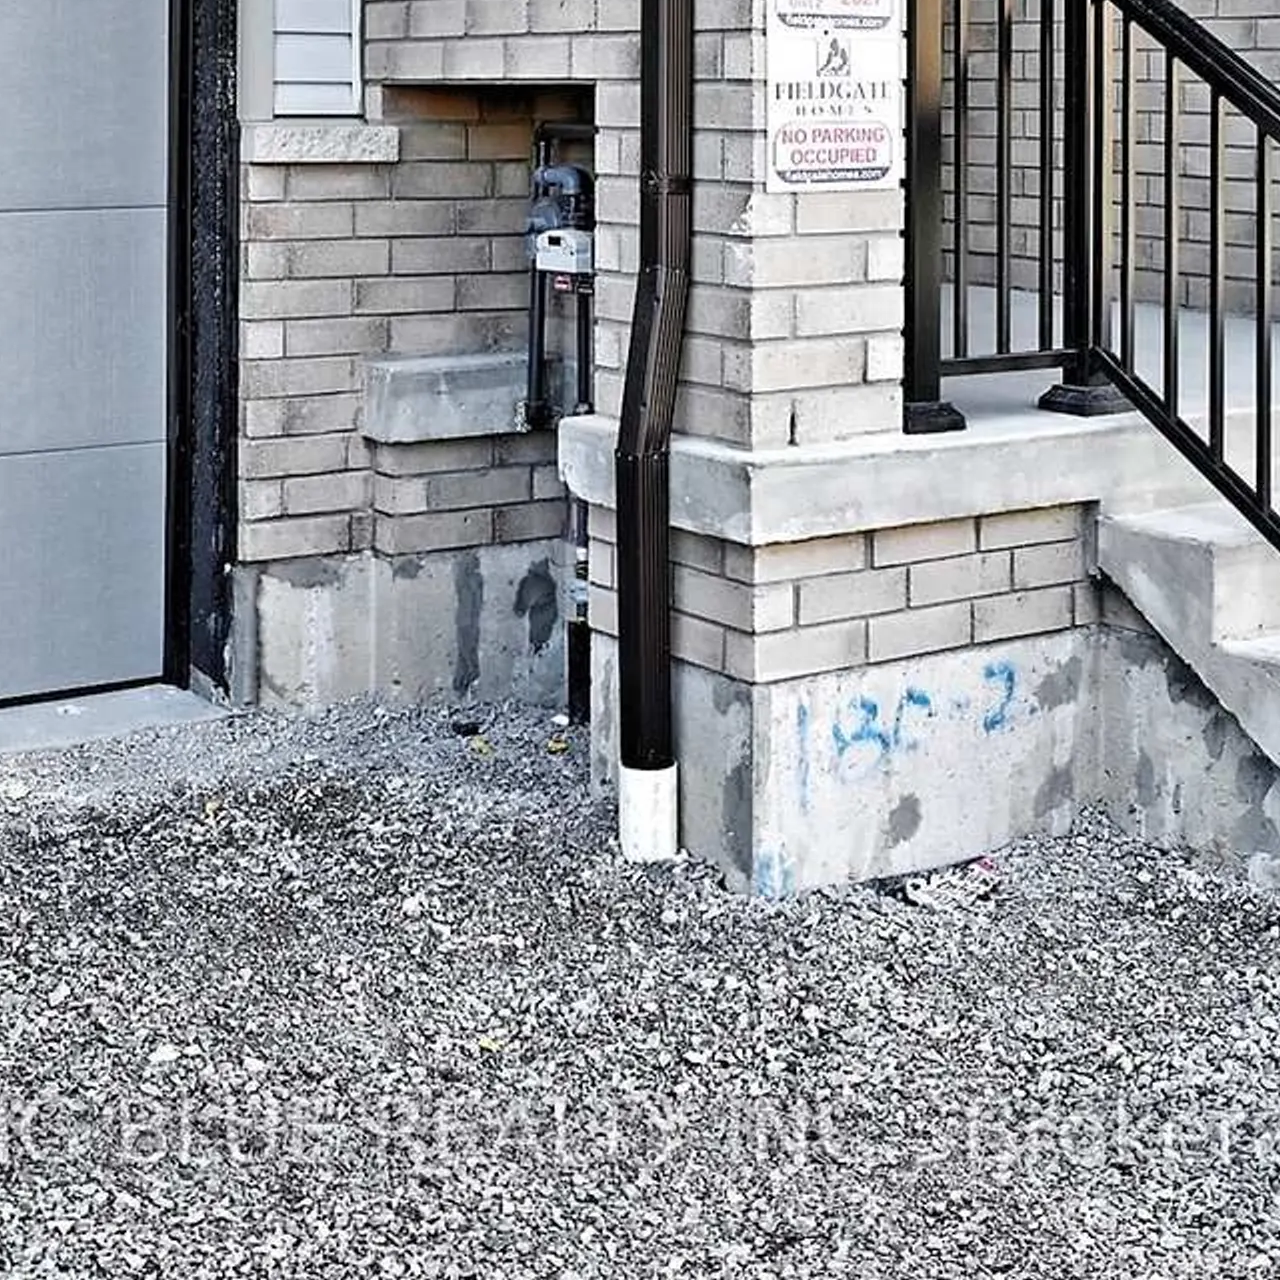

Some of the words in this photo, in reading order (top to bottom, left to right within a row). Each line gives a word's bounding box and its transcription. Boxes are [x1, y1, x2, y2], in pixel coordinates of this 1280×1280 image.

[776, 81, 891, 101] FIELDGATE
[781, 127, 807, 145] NO
[811, 126, 886, 144] PARKING
[790, 147, 878, 166] OCCUPIED
